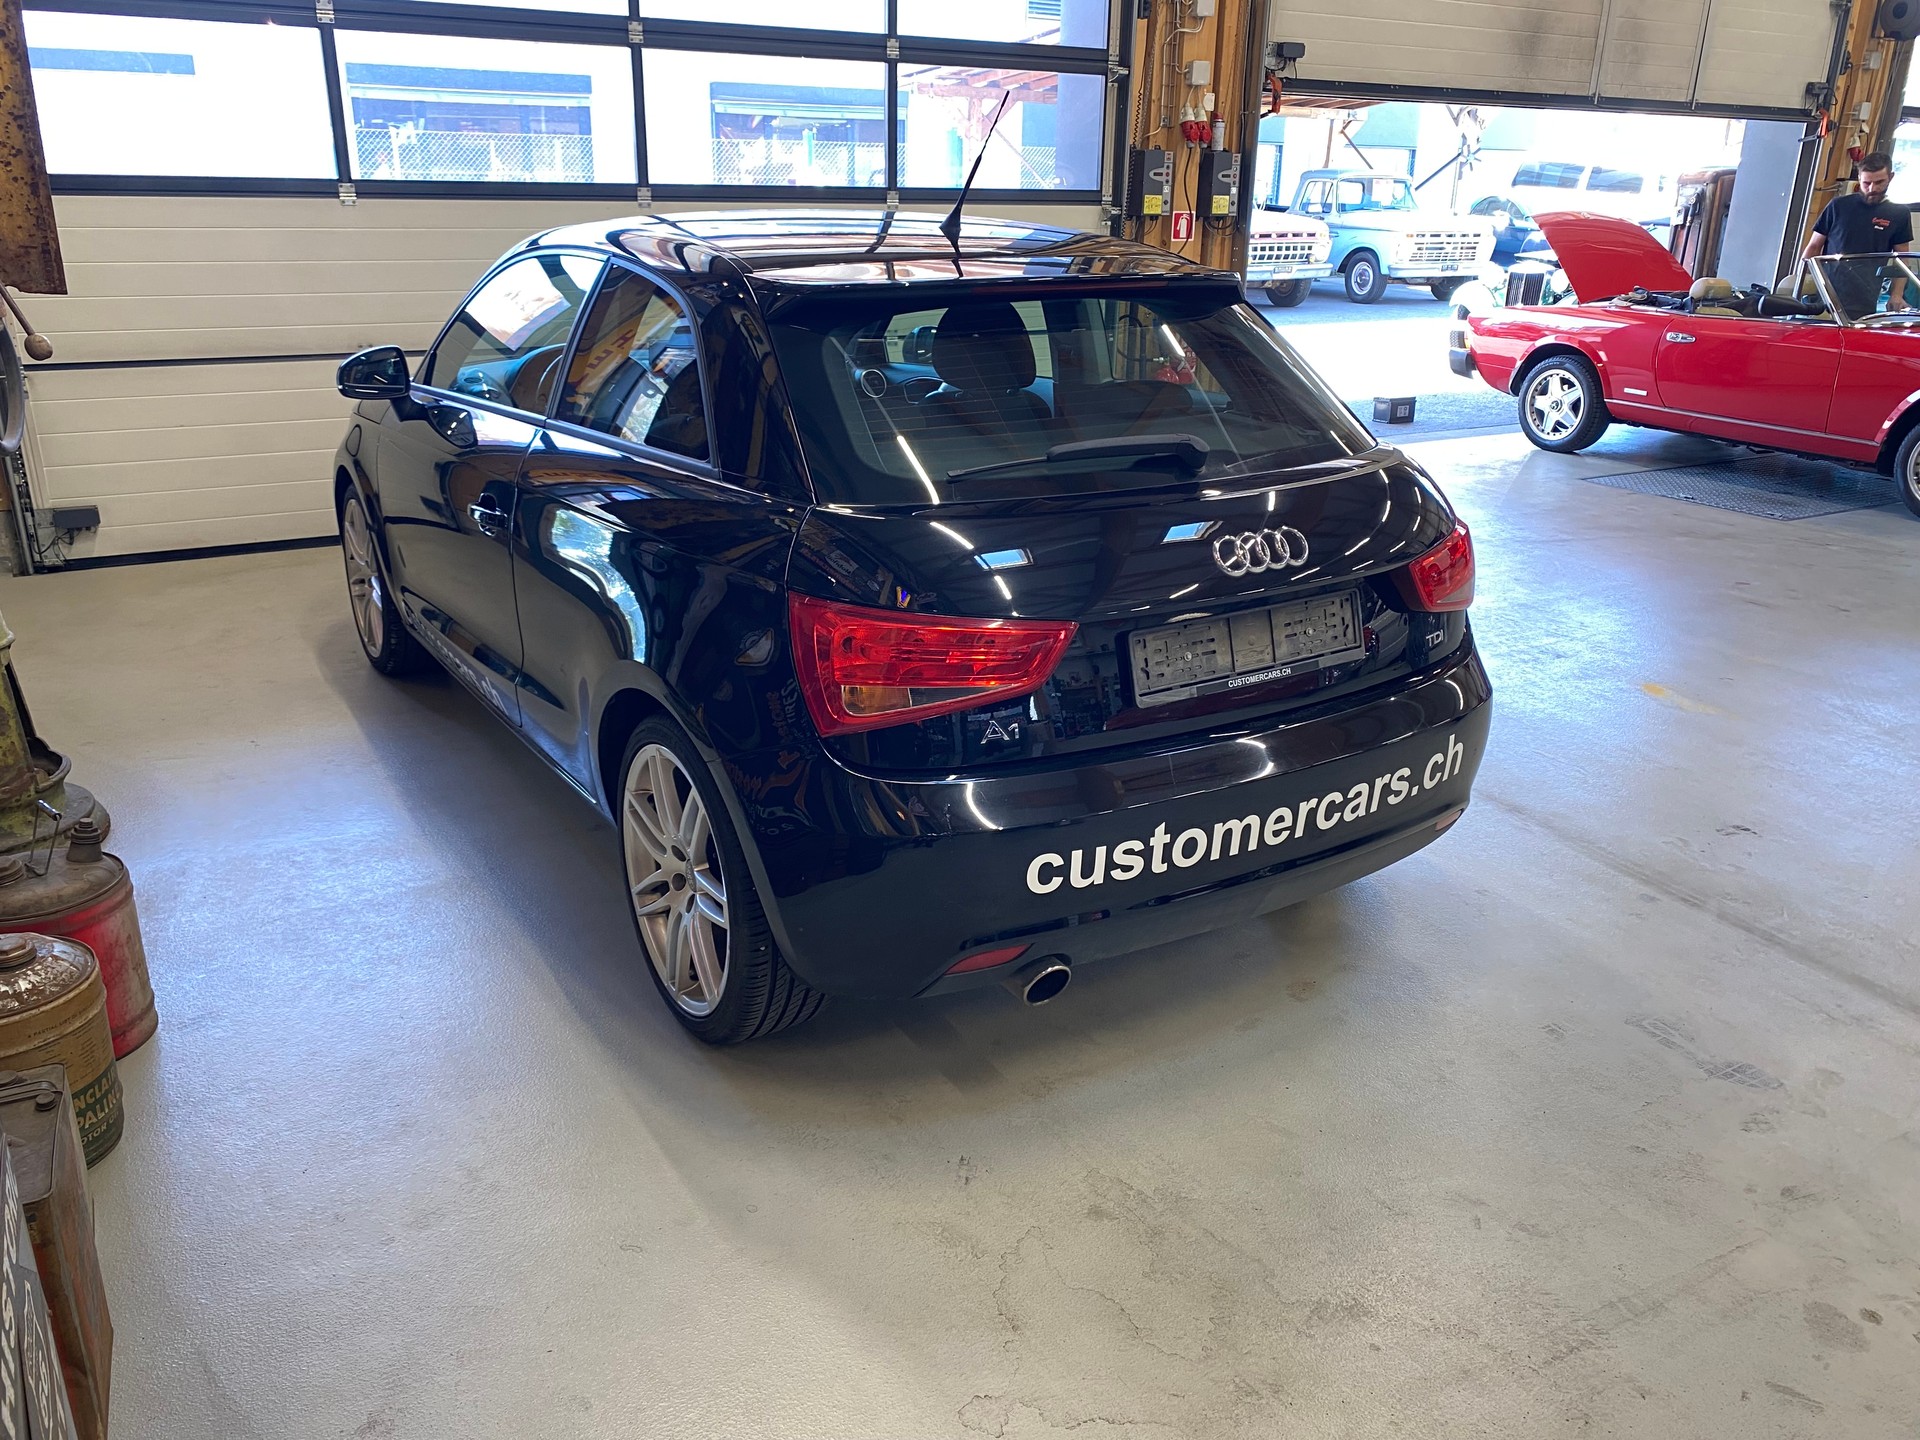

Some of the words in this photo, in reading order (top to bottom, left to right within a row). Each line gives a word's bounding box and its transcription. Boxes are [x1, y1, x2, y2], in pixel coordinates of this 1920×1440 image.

[1425, 629, 1444, 647] TDI
[1228, 667, 1291, 688] CUSTOMERCARS.CH
[980, 719, 1020, 745] A1
[1026, 732, 1465, 895] customercars.ch
[81, 1122, 108, 1146] OTOR
